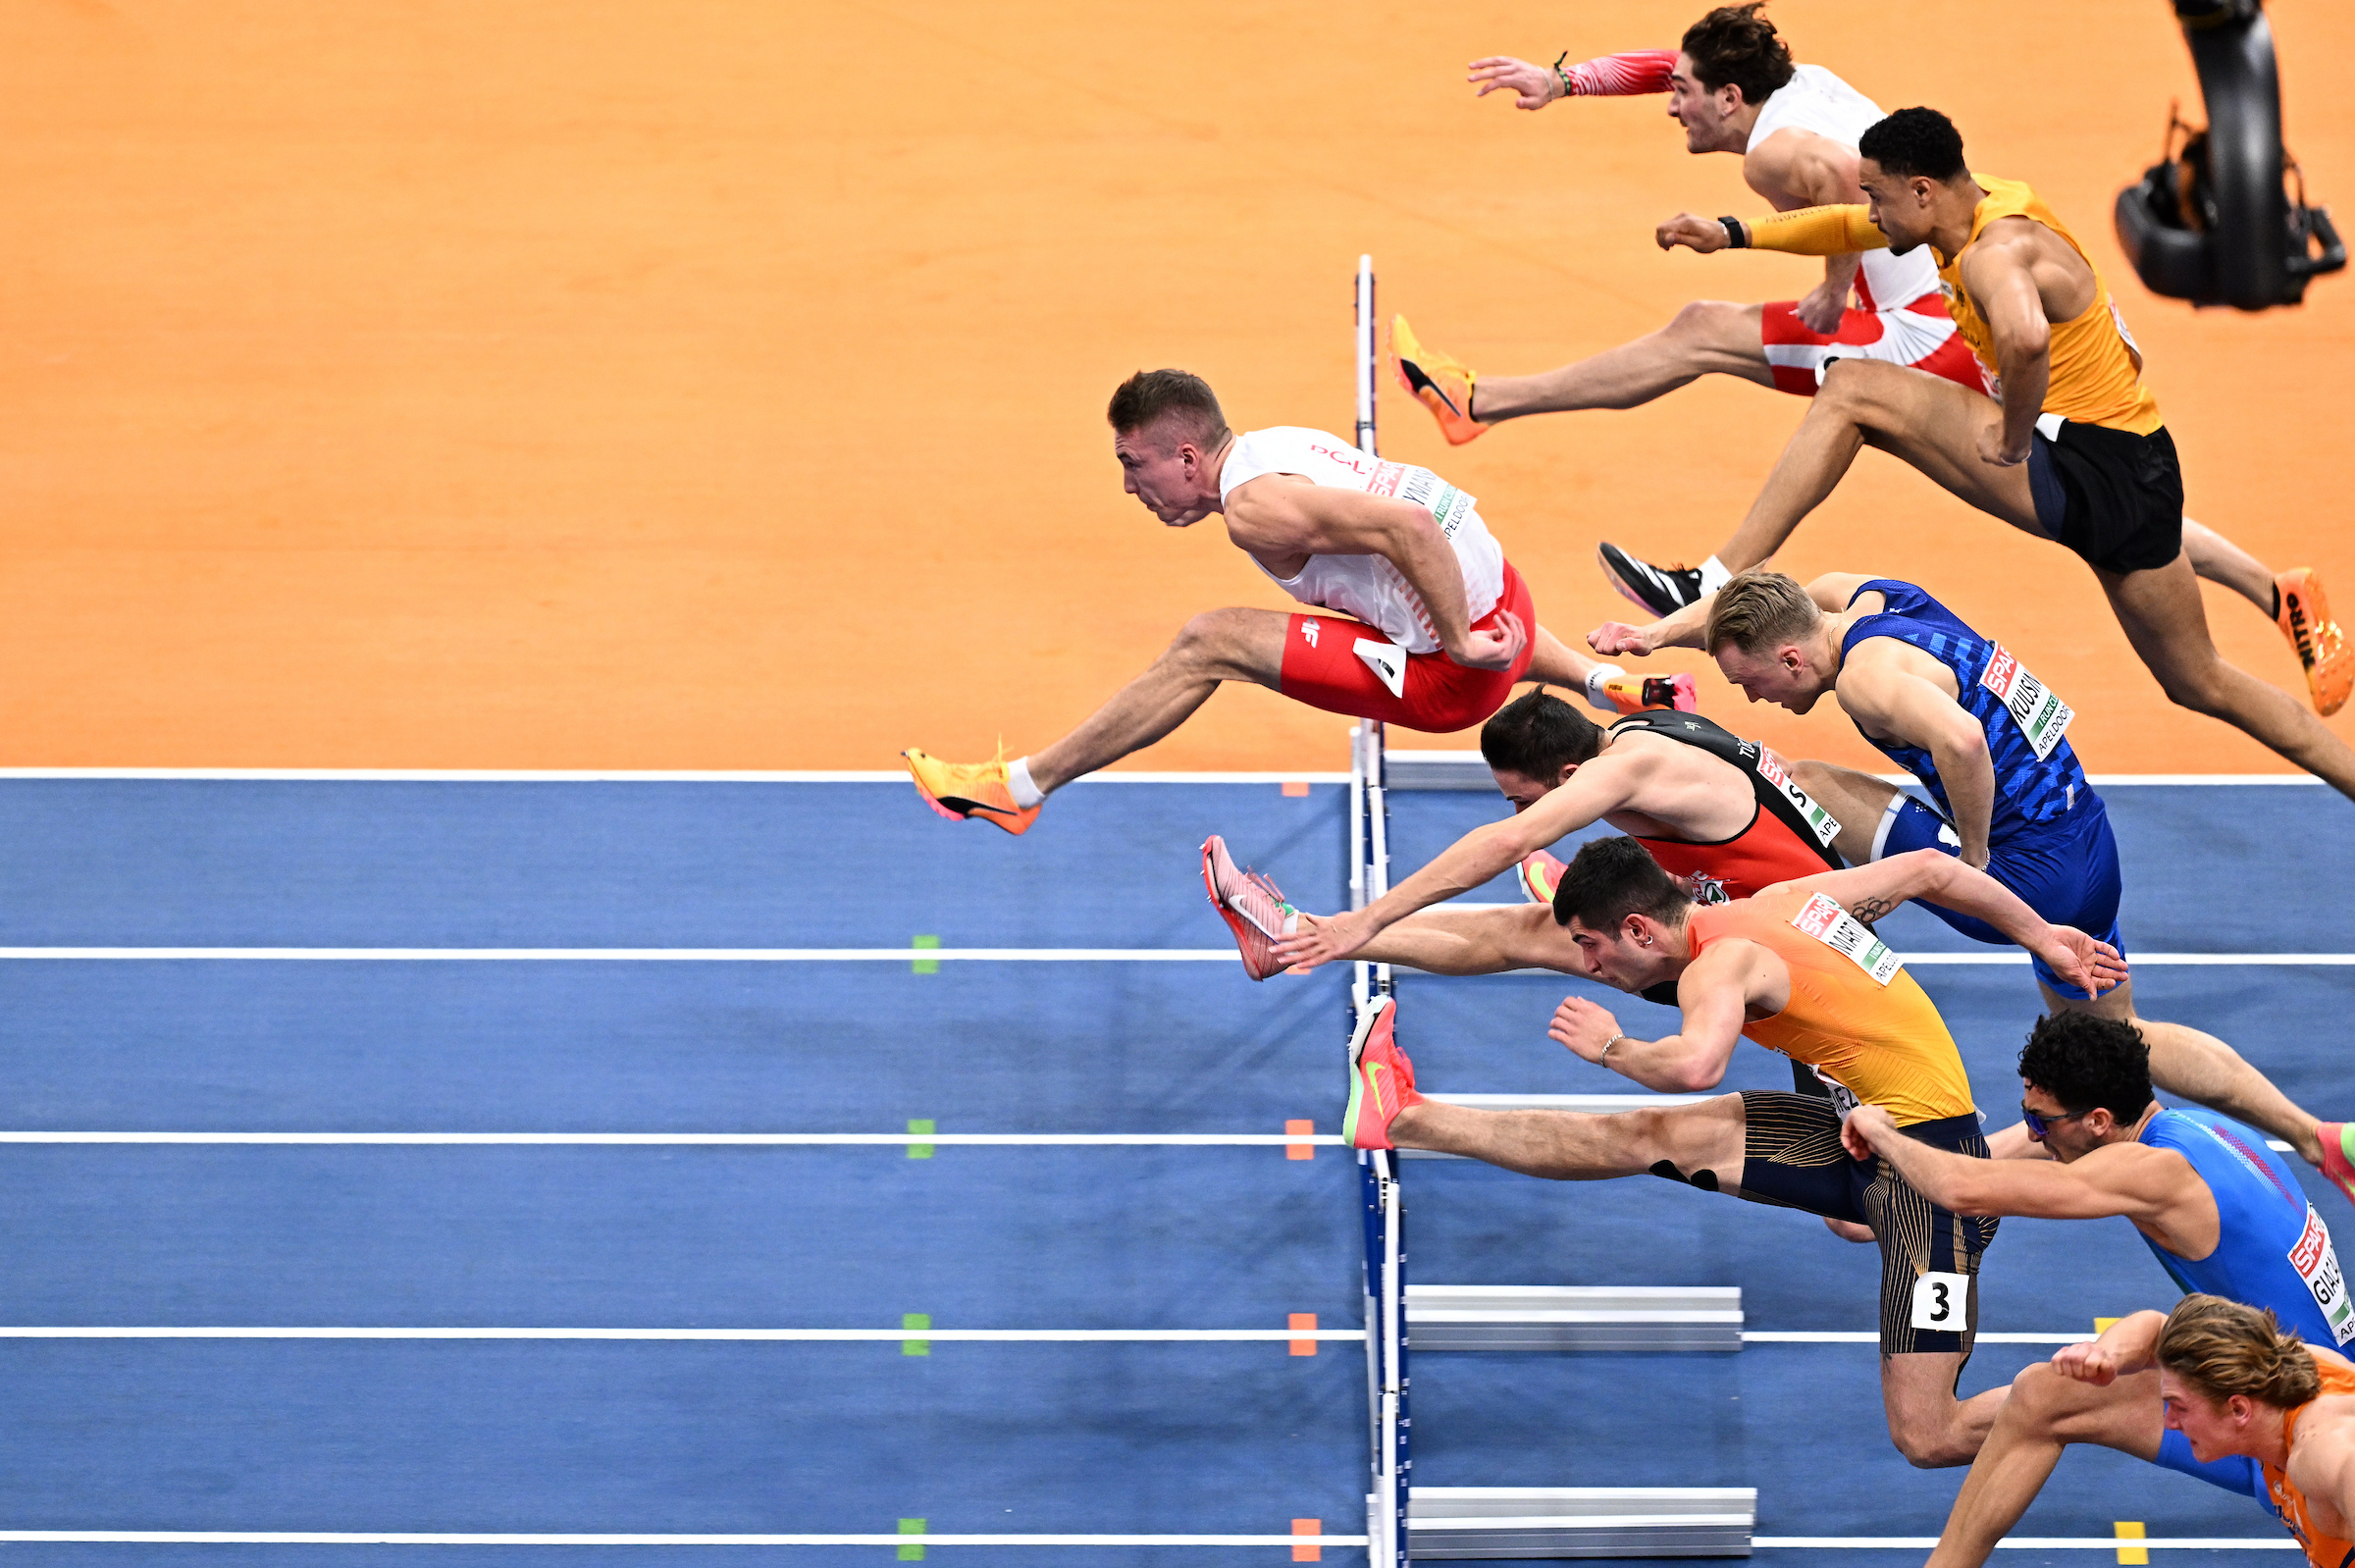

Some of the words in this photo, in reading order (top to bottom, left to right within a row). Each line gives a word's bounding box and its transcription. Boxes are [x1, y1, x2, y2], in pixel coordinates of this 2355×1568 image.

[2286, 593, 2315, 673] NITRO
[2039, 705, 2054, 723] RUN
[2294, 1220, 2325, 1274] SPAR
[1930, 1282, 1950, 1322] 3
